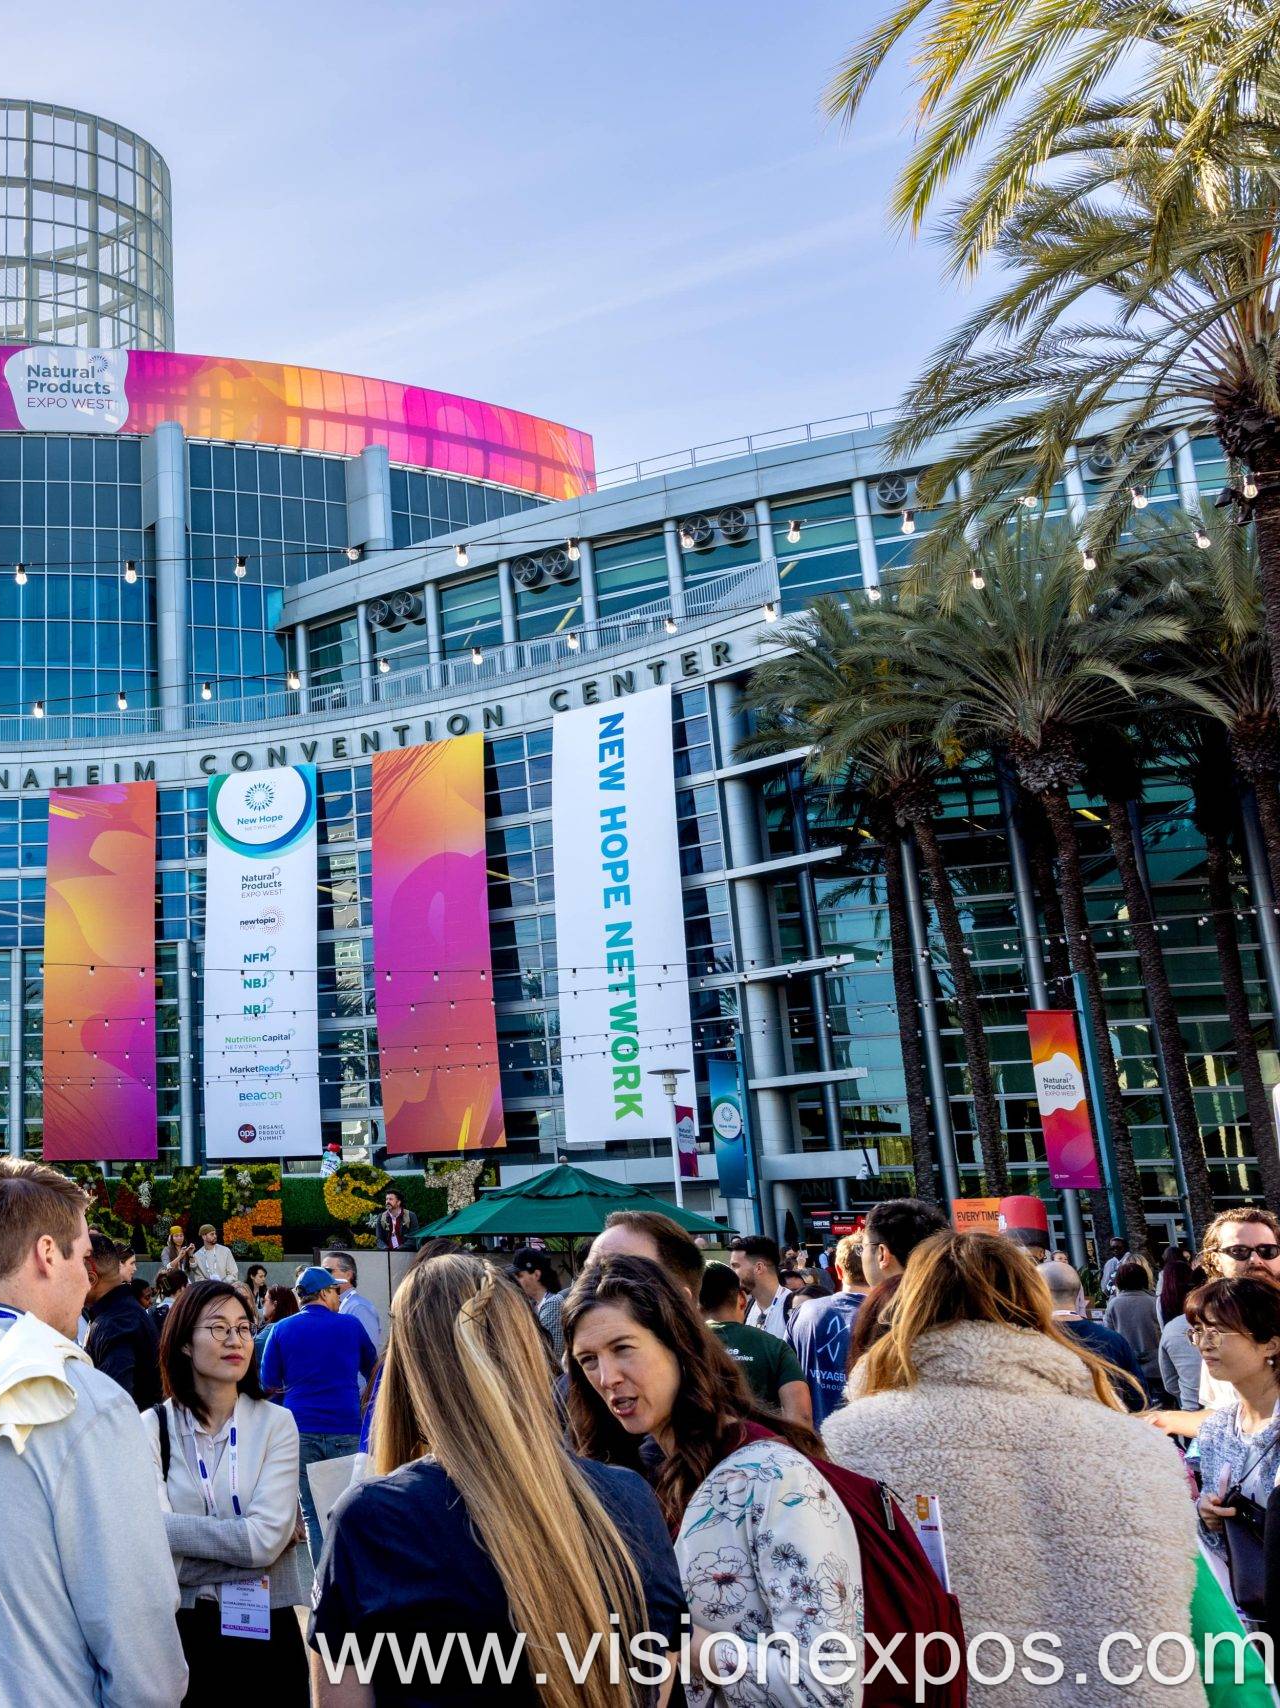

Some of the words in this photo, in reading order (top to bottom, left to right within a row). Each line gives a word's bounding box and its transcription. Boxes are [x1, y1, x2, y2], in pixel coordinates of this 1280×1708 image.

[27, 364, 95, 379] Natural
[27, 380, 111, 395] Products
[27, 397, 68, 409] EXPO
[71, 397, 113, 410] WEST
[199, 703, 503, 776] CONVENTION
[549, 641, 732, 712] CENTER
[598, 711, 626, 791] NEW
[237, 817, 257, 826] New
[259, 814, 283, 823] Hope
[599, 805, 631, 910] HOPE
[241, 872, 275, 883] Natural
[241, 880, 282, 891] Products
[241, 890, 261, 899] EXPO
[263, 889, 283, 897] WEST
[239, 916, 276, 926] newtopia
[243, 953, 269, 963] NFM
[243, 978, 267, 989] NBJ
[243, 1004, 267, 1015] NBJ
[605, 920, 644, 1121] NETWORK
[229, 1064, 285, 1074] MarketReady
[1044, 1083, 1076, 1091] Products
[239, 1091, 282, 1101] Beacon
